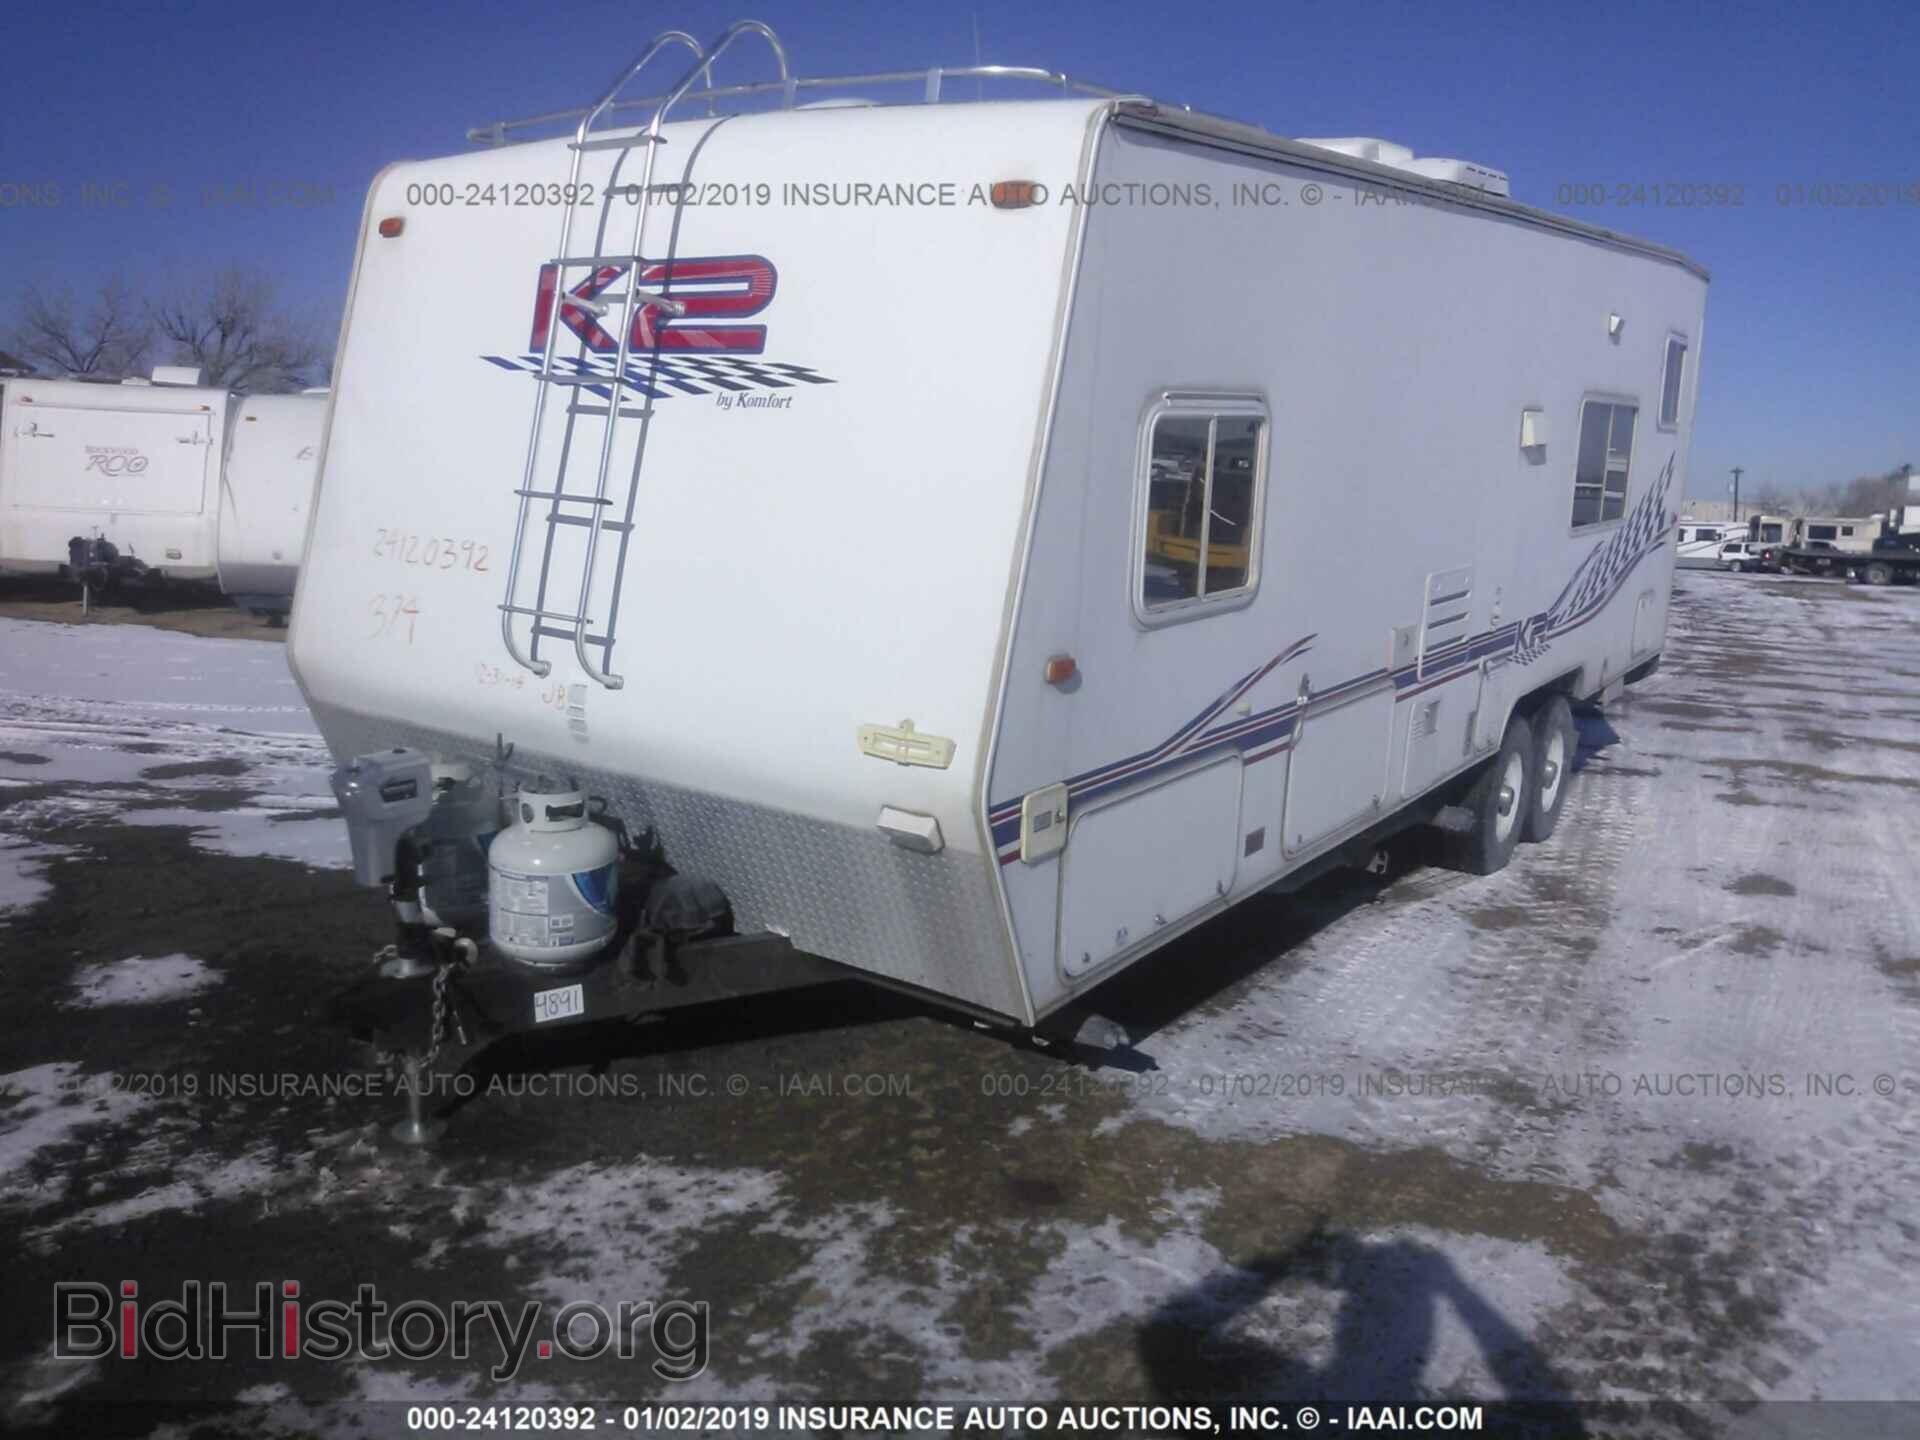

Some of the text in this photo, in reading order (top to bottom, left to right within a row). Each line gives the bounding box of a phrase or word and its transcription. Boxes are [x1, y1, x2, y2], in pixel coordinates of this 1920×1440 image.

[529, 254, 778, 354] K2
[715, 391, 793, 410] by Komfort
[373, 528, 489, 573] 24120392
